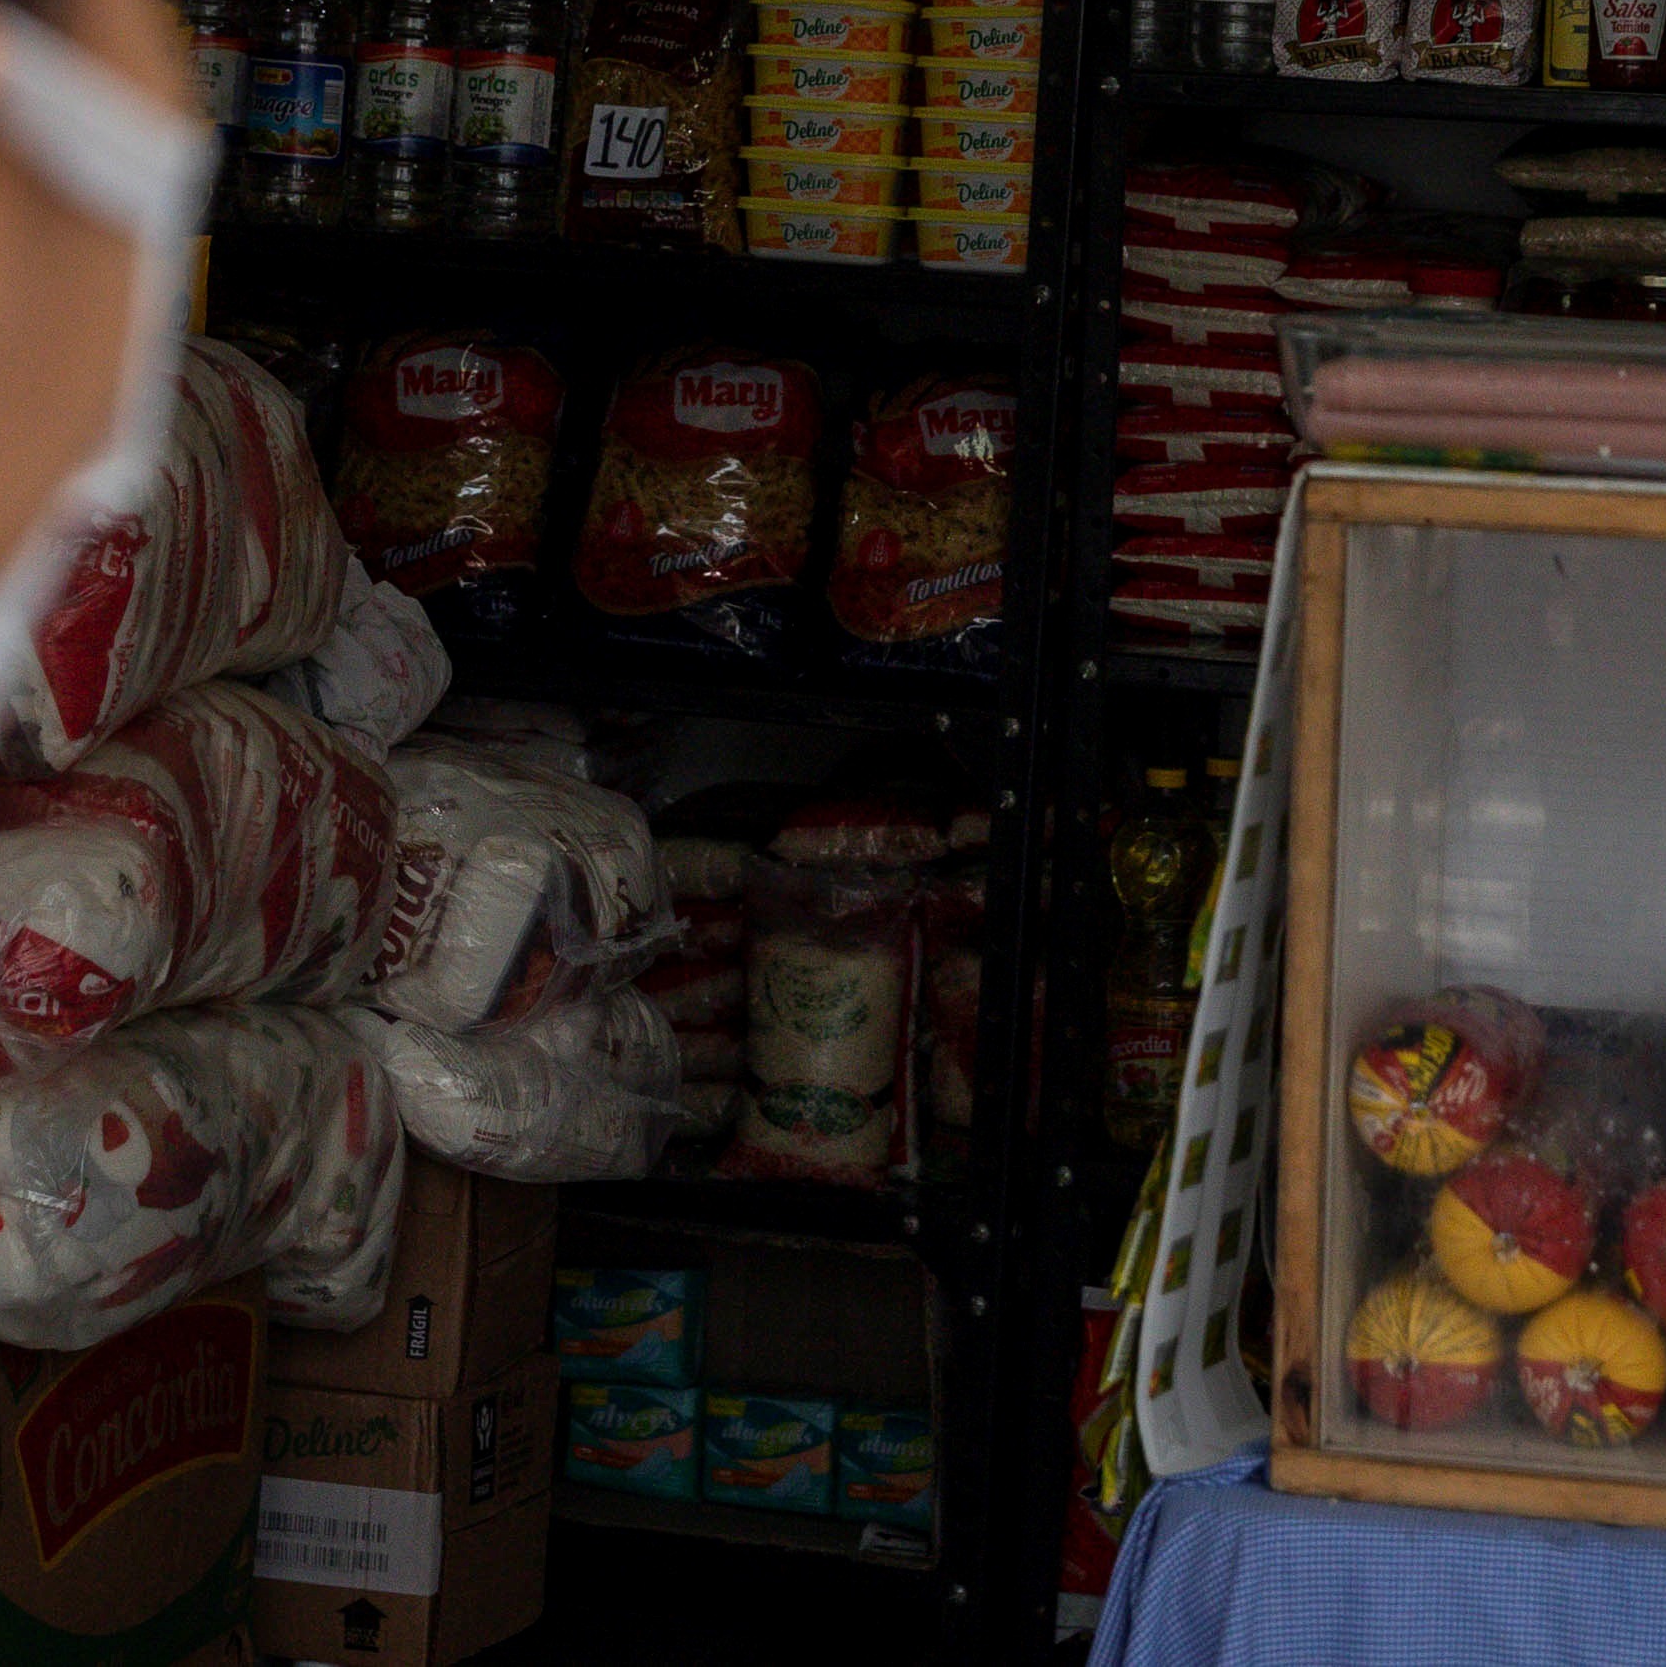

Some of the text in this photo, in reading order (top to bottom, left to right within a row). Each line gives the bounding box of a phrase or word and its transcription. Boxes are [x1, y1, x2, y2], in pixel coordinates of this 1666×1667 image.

[792, 15, 848, 39] Deline
[968, 26, 1024, 49] Deline
[1611, 20, 1651, 35] Tomate
[1298, 41, 1368, 66] BRASIL
[368, 61, 420, 88] arias
[466, 64, 519, 96] arias
[792, 67, 851, 90] Deline
[590, 109, 665, 172] 140
[400, 360, 501, 405] Mary
[679, 372, 783, 420] Mary
[905, 558, 1006, 604] Tornillos
[44, 1339, 241, 1528] Concórdia
[262, 1415, 380, 1462] Deline
